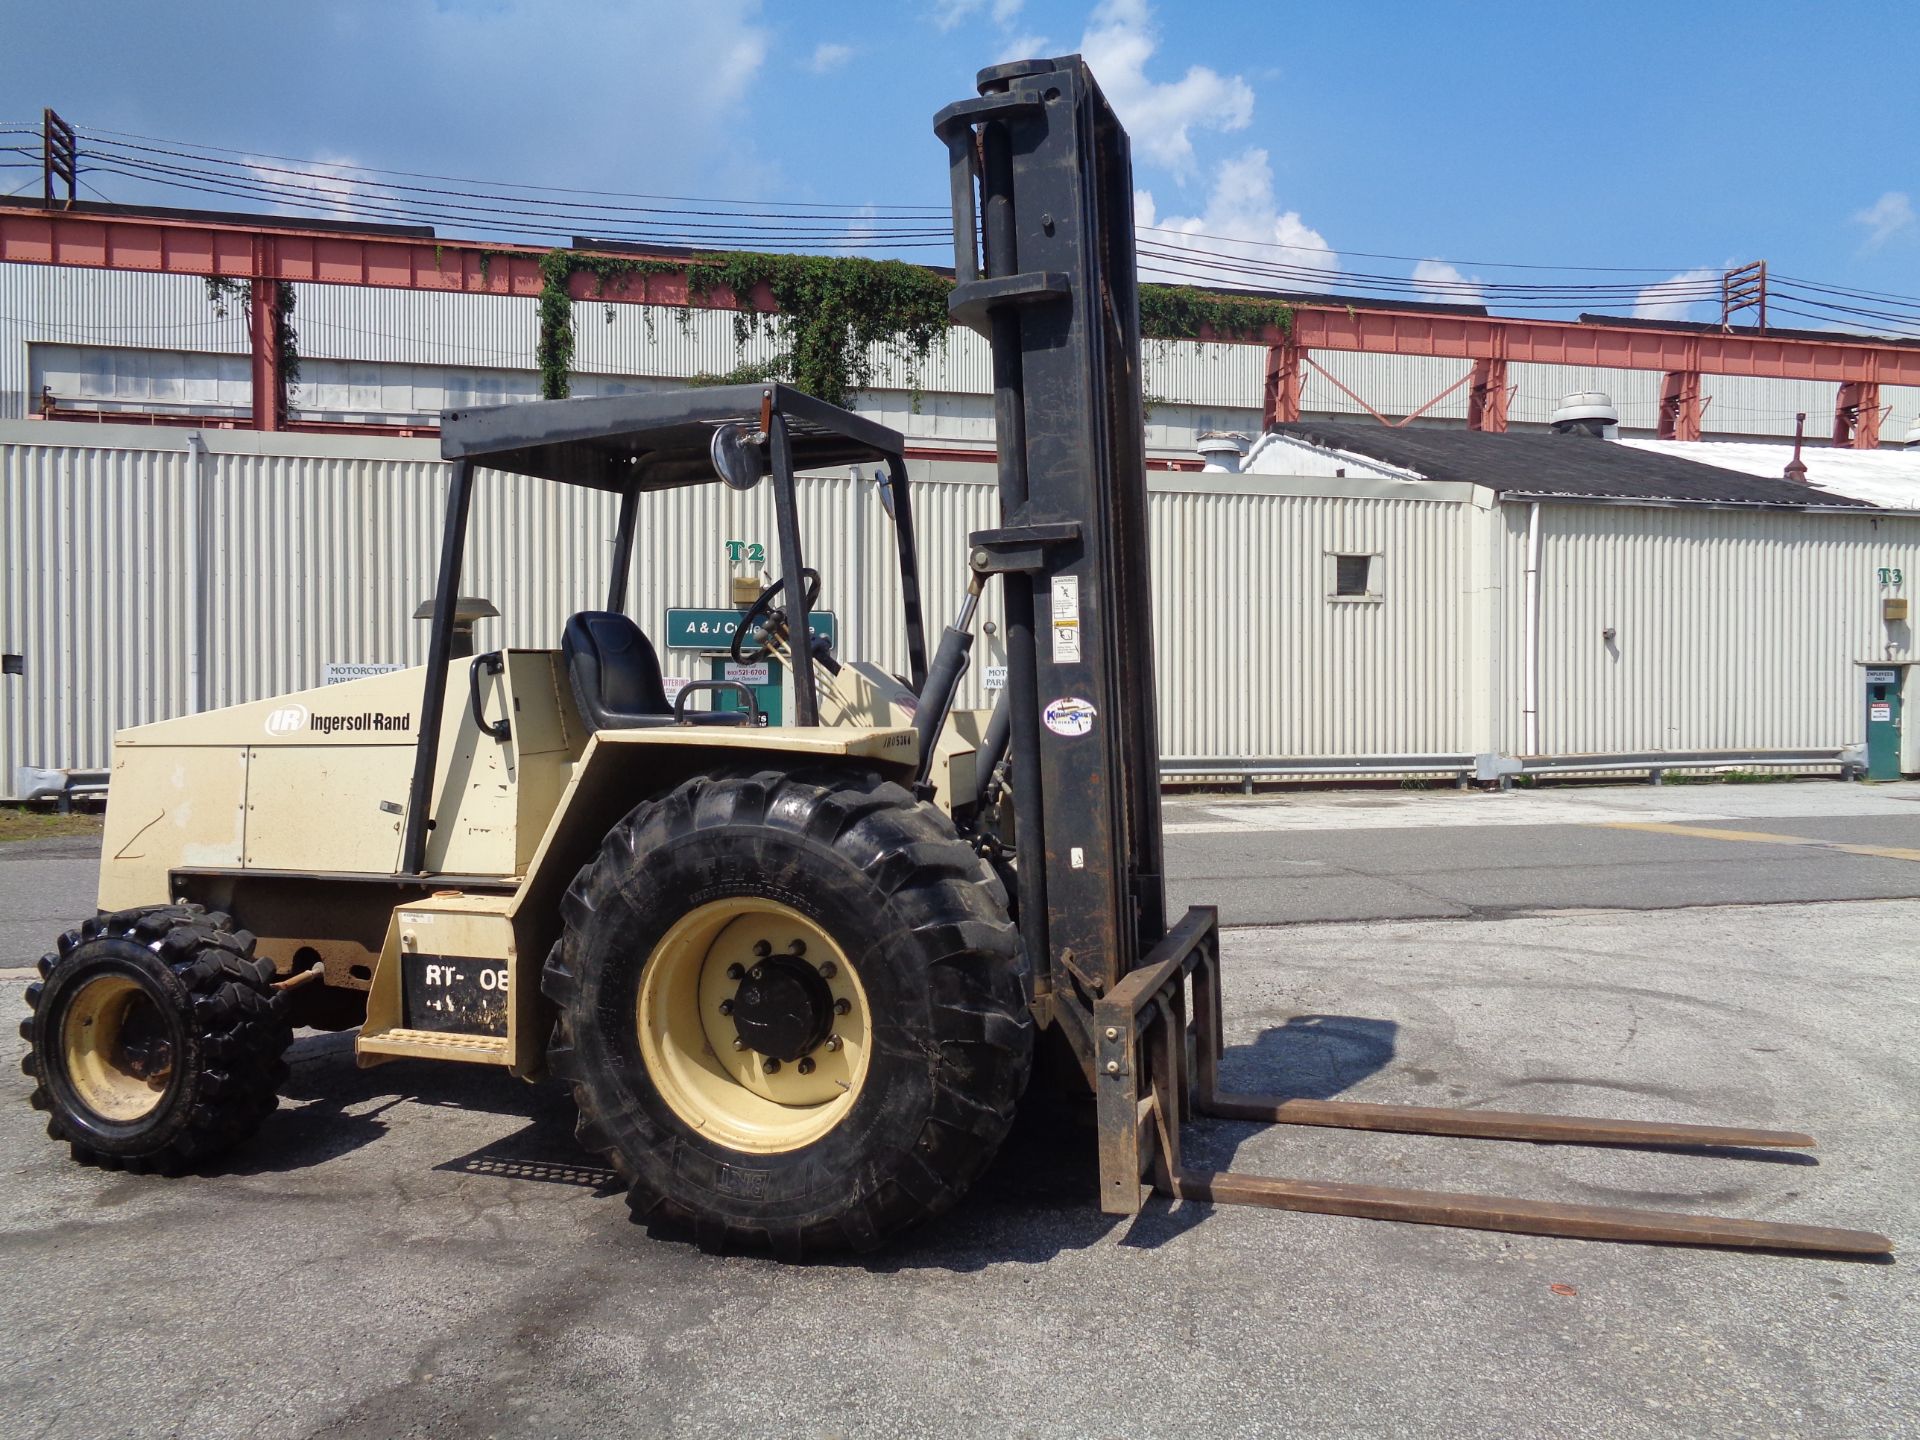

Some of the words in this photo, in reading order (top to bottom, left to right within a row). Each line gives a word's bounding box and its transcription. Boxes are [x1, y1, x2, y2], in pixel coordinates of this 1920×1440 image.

[1877, 567, 1903, 584] T3
[686, 622, 696, 633] A
[699, 622, 709, 633] &
[712, 622, 720, 633] J
[724, 622, 760, 634] Cle
